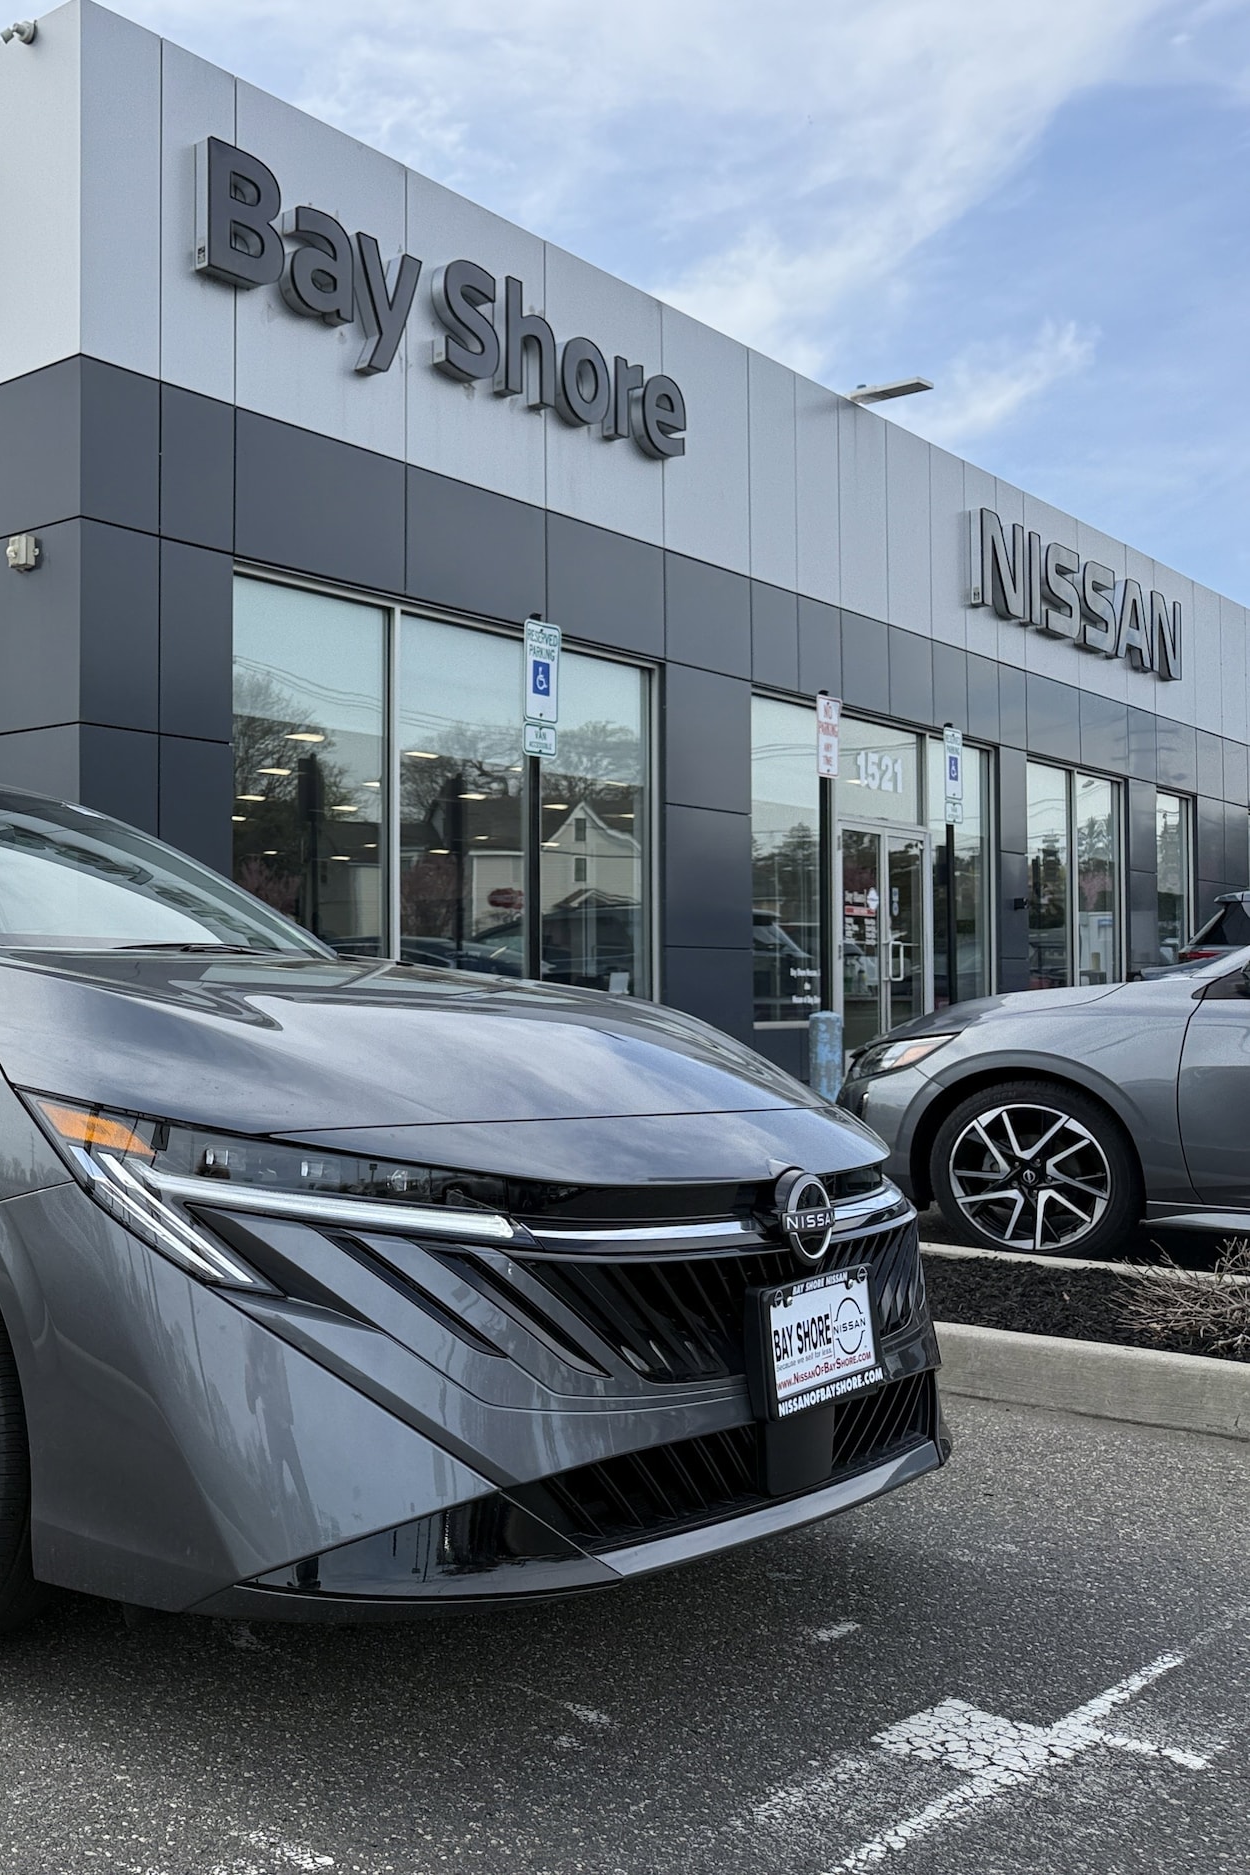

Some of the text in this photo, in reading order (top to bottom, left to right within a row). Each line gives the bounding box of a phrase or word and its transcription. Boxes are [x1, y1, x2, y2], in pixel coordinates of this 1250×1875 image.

[195, 136, 686, 460] Bay Shore
[969, 507, 1182, 681] NISSAN
[527, 629, 559, 647] RESERVED
[529, 644, 556, 662] PARKING
[857, 751, 903, 794] 1521
[792, 1271, 848, 1296] BAY SHORE NISSAN
[773, 1313, 832, 1362] BAY SHORE
[833, 1317, 866, 1335] NISSAN
[778, 1367, 884, 1418] NISSANOFBAYSHORE.COM
